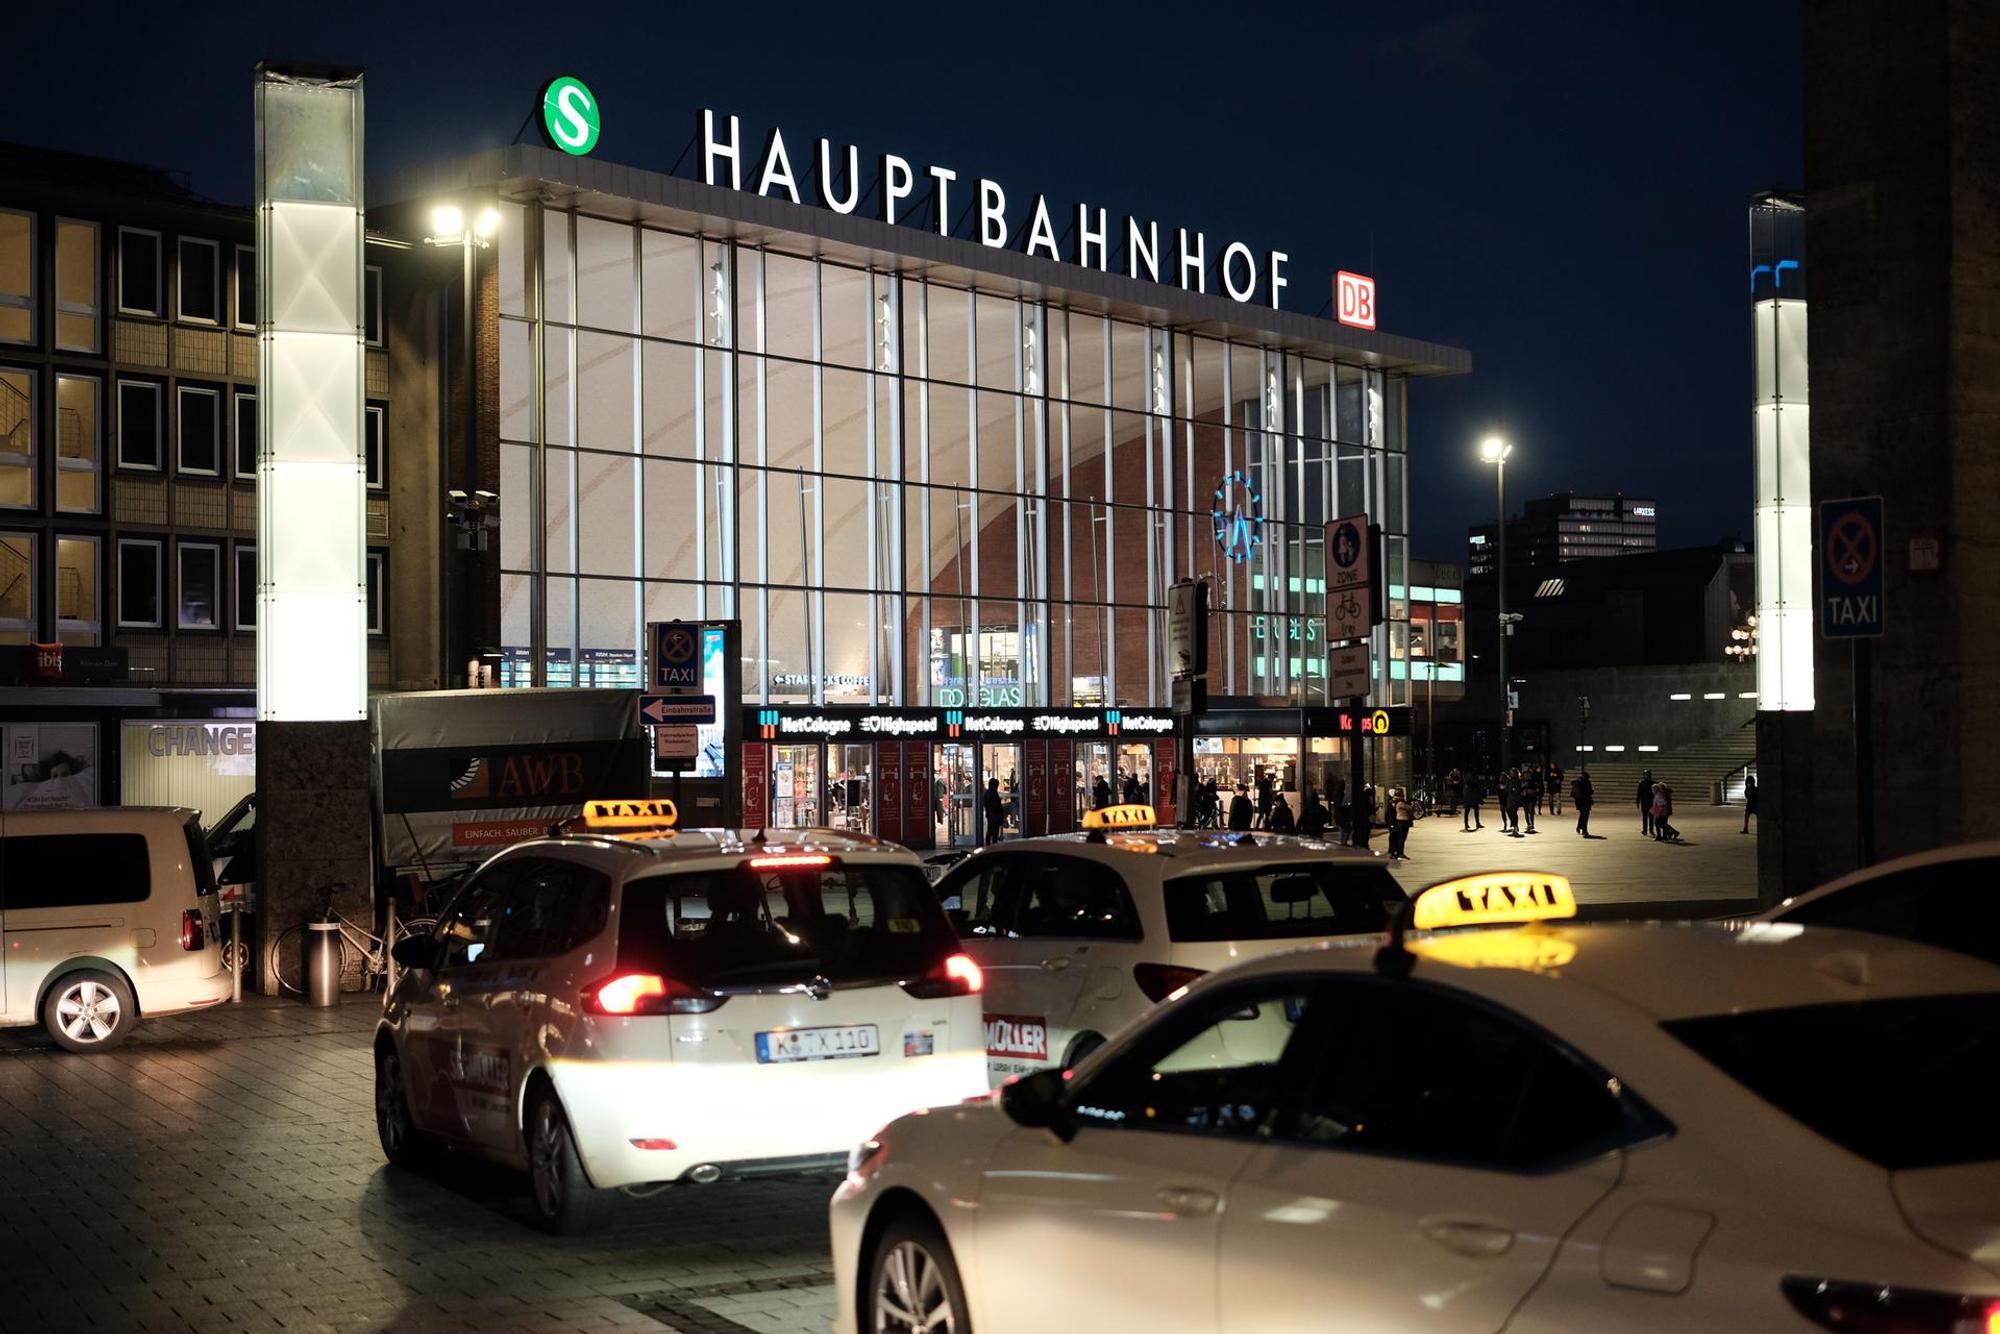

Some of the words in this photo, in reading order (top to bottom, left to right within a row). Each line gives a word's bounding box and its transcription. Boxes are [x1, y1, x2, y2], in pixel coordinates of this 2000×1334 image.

[554, 84, 592, 148] S
[704, 108, 1290, 310] HAUPTBAHNHOF
[1343, 280, 1371, 321] DB
[1336, 569, 1358, 584] ZONE
[1827, 594, 1878, 625] TAXI
[38, 652, 62, 672] ibis
[661, 667, 695, 682] TAXI
[940, 687, 1020, 708] DOGLAS
[661, 705, 712, 714] Einbahnstraße
[781, 716, 851, 735] NetCologne
[881, 715, 937, 735] Highspeed
[965, 715, 1024, 735] NetCologne
[1049, 715, 1099, 734] Highspeed
[1122, 715, 1173, 733] NetCologne
[148, 726, 254, 758] CHANGE
[496, 752, 586, 797] AWB
[600, 803, 668, 817] TAXI
[1103, 809, 1146, 824] TAXI
[1459, 885, 1554, 911] TAXI
[835, 1029, 870, 1050] 110
